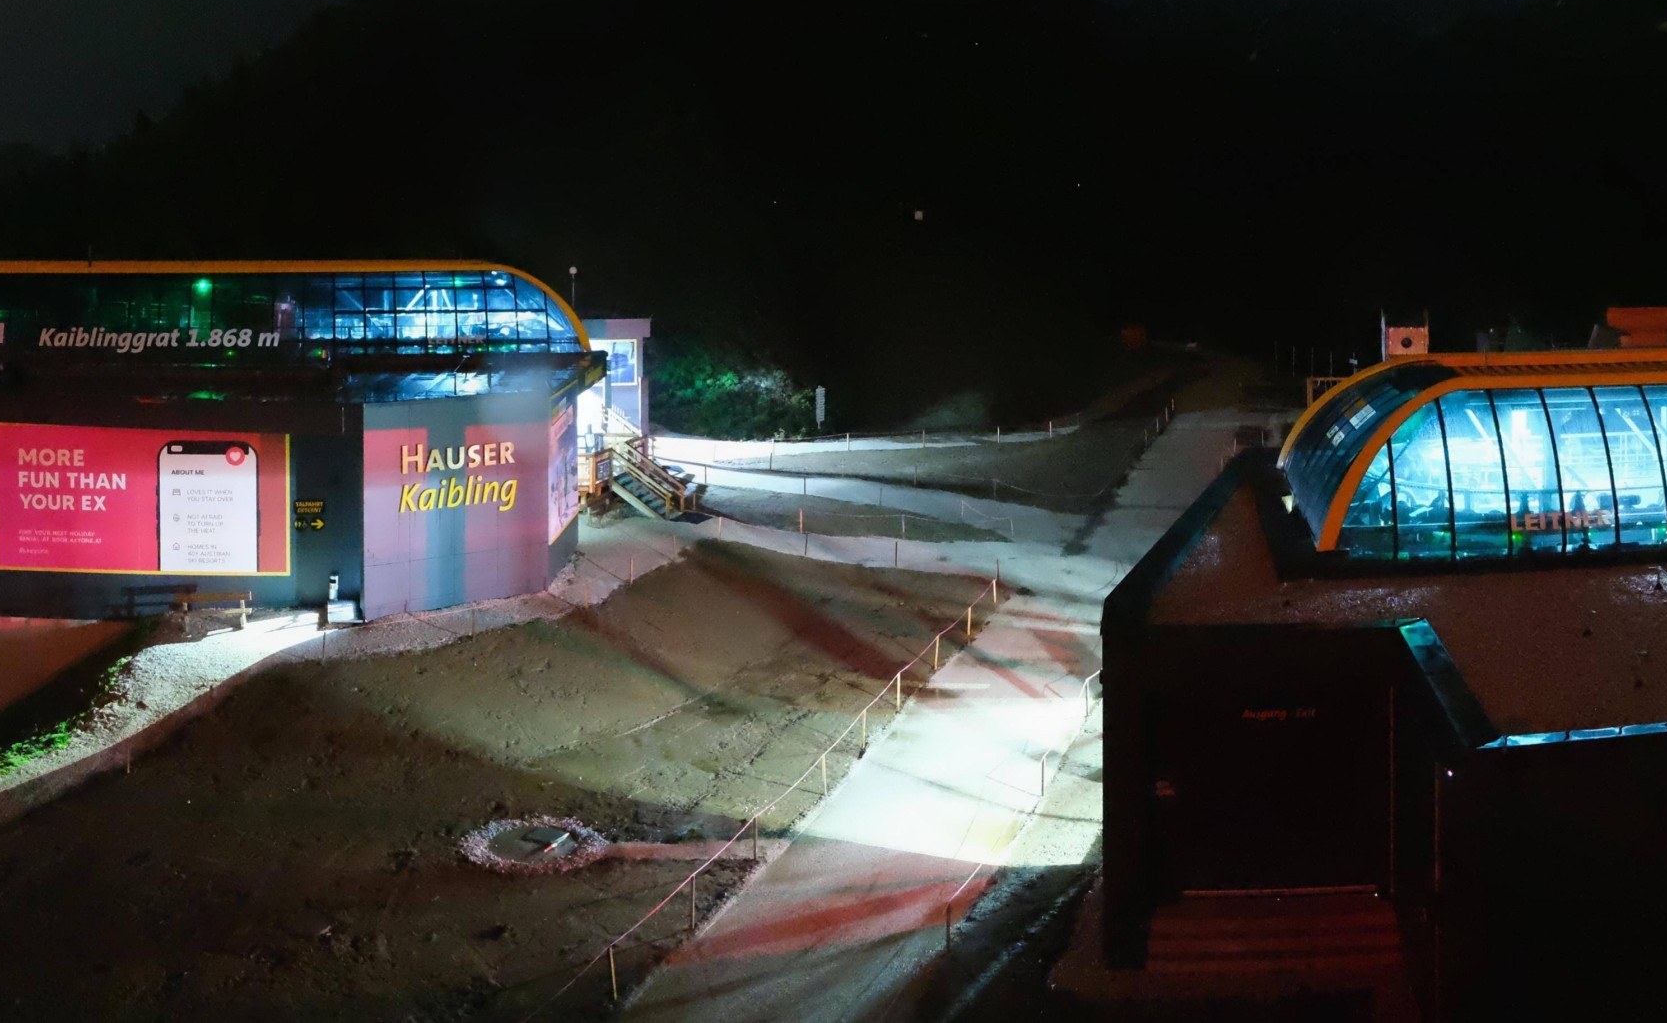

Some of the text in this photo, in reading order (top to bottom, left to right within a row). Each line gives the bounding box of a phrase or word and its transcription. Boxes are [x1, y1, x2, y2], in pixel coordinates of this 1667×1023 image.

[38, 327, 280, 353] Kaiblinggrat 1.868 m
[18, 448, 85, 467] MORE
[401, 442, 515, 475] HAUSER
[18, 471, 126, 490] FUN THAN
[19, 493, 107, 511] YOUR EX
[399, 475, 518, 514] Kaibling
[1510, 509, 1612, 531] LEITNER
